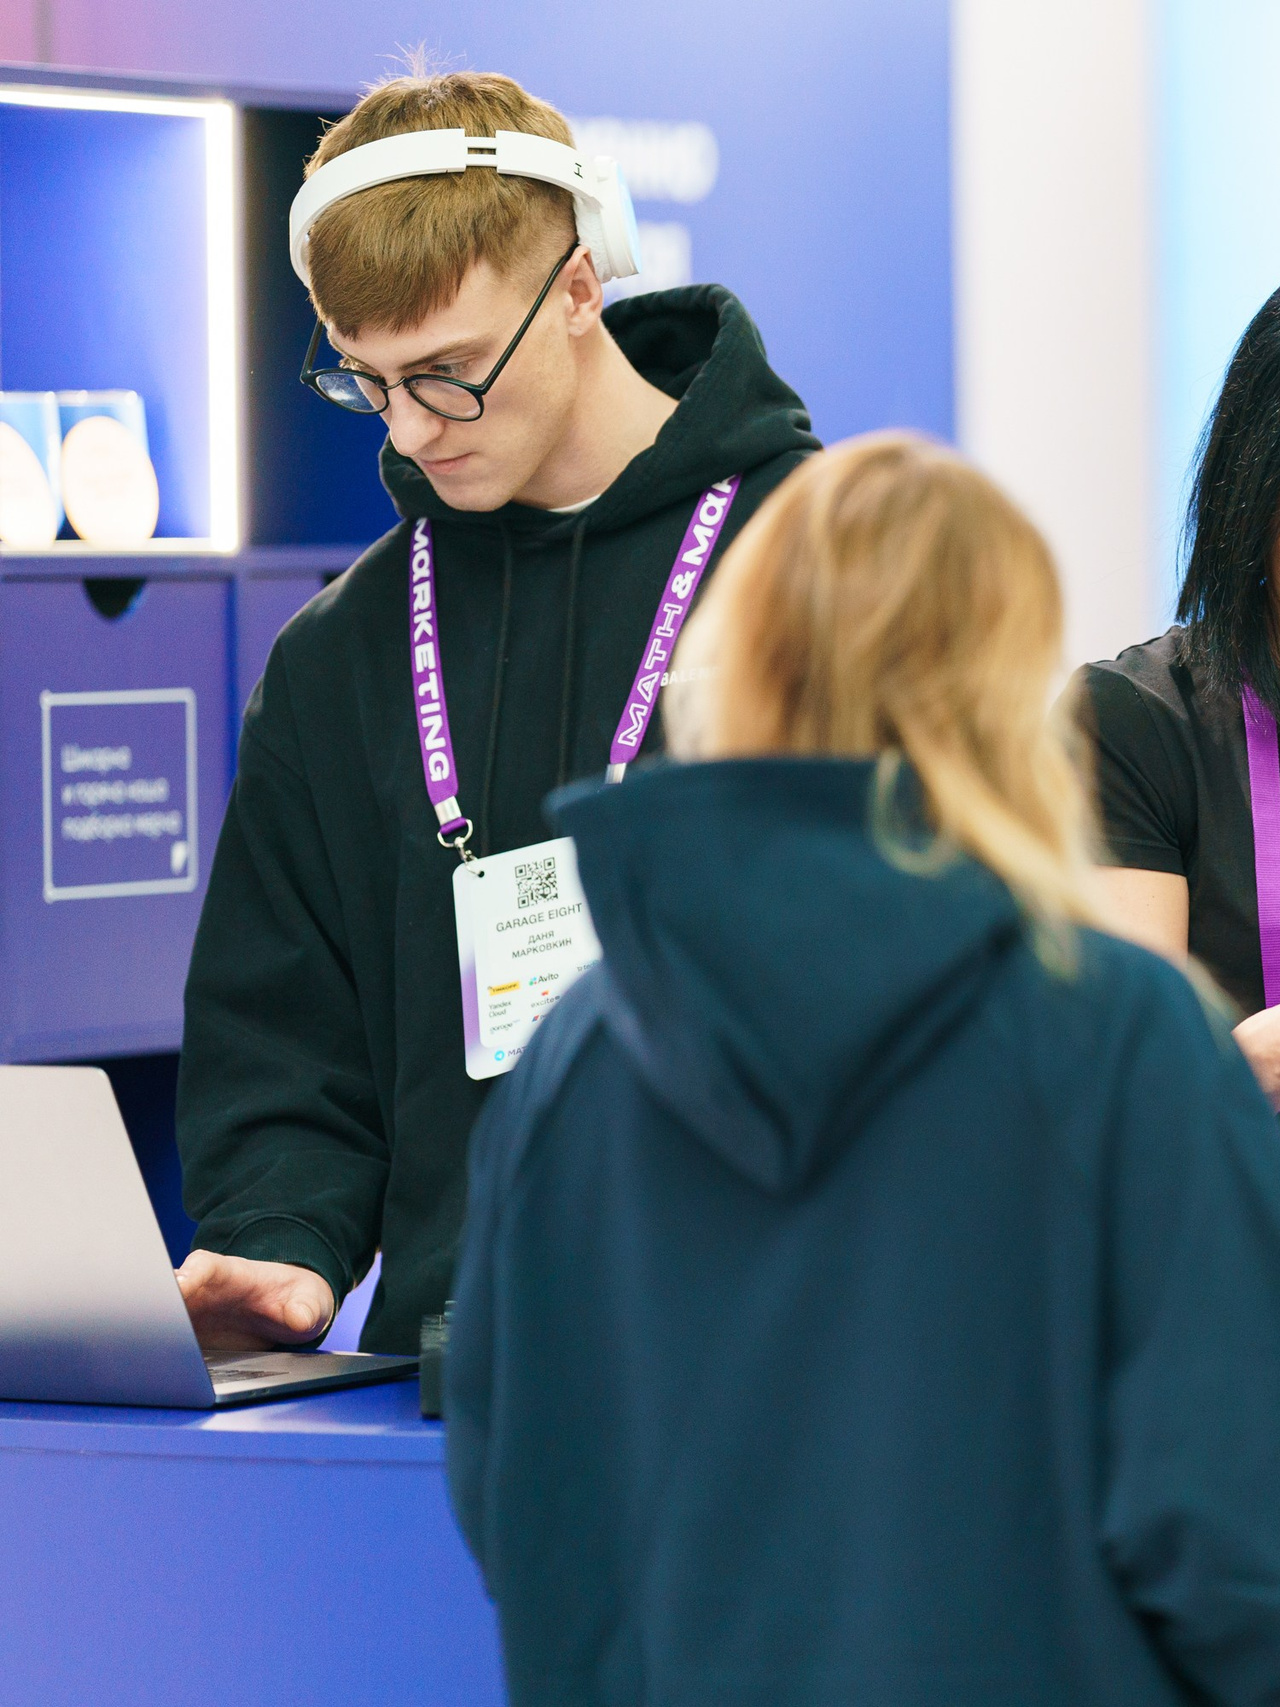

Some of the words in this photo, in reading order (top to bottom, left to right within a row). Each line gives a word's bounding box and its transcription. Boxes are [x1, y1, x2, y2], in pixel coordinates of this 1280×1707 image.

[617, 603, 683, 748] MATH
[671, 570, 697, 600] &
[495, 911, 545, 932] GARAGE
[549, 902, 583, 920] EIGHT
[511, 937, 572, 959] МАРКОВКИН
[528, 930, 555, 945] ДАНЯ
[538, 972, 559, 984] Avito
